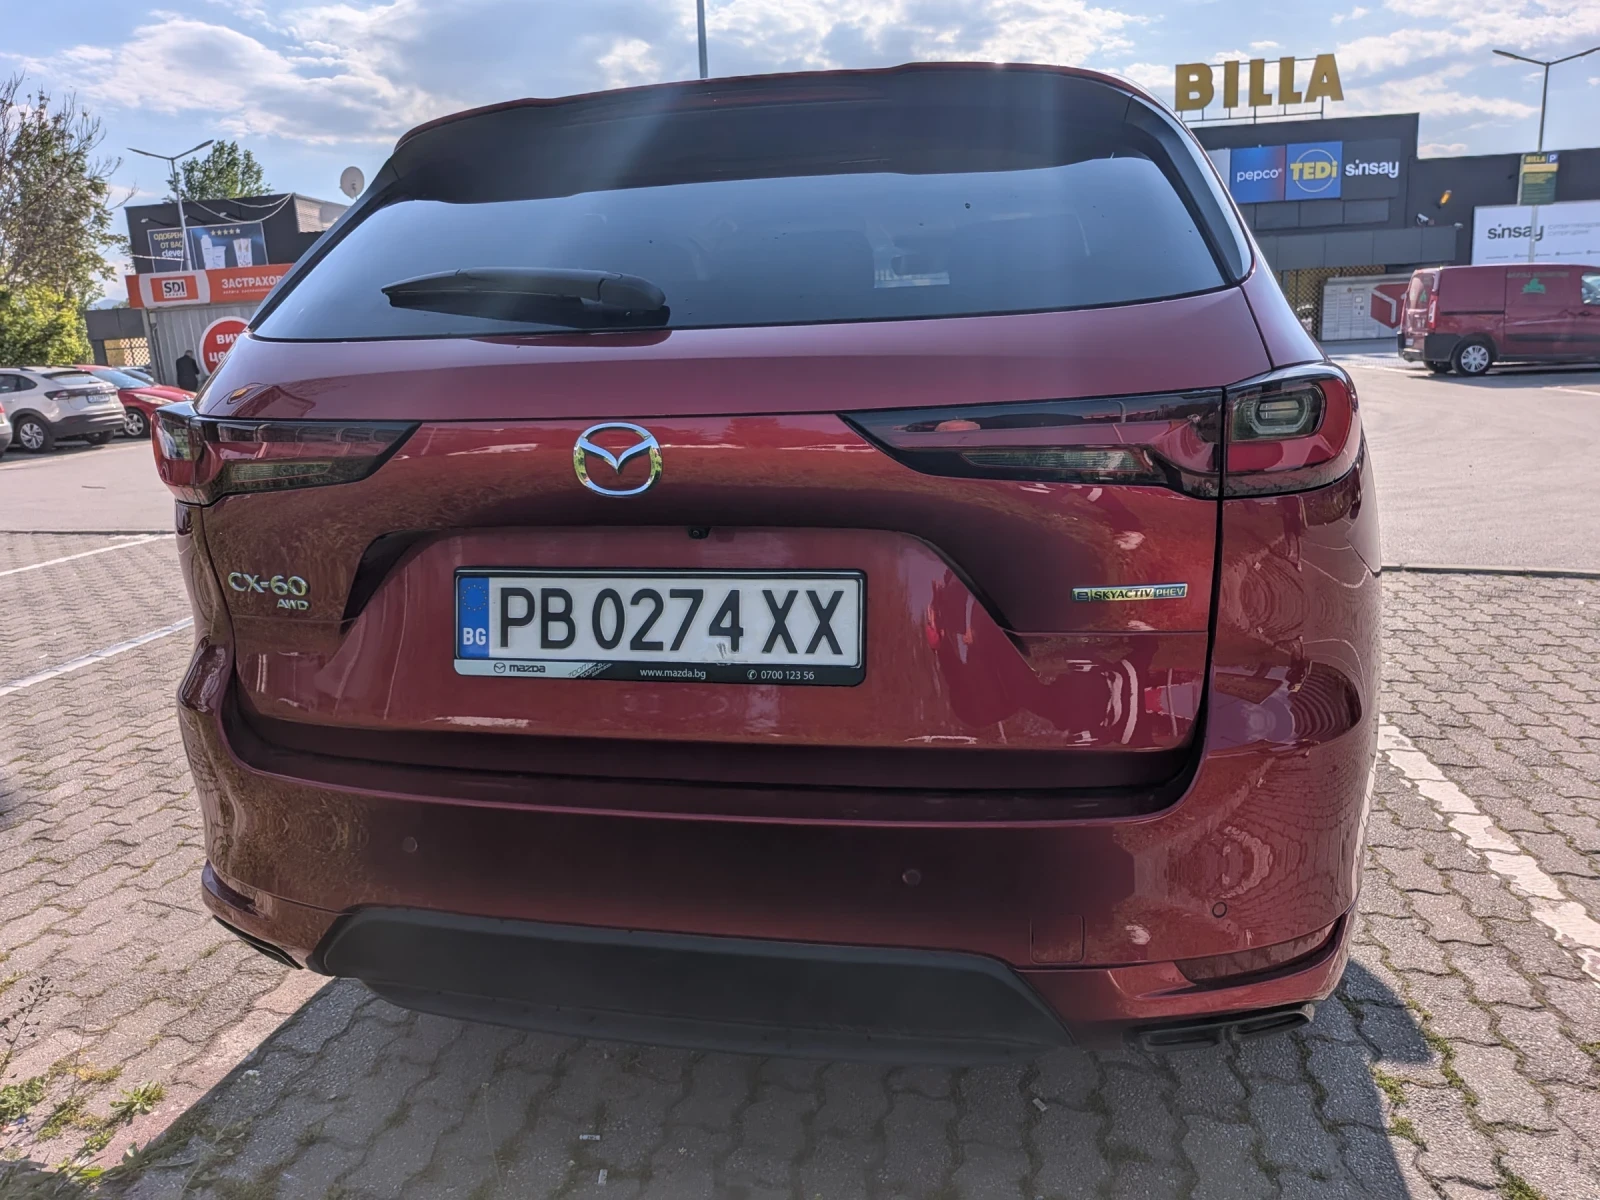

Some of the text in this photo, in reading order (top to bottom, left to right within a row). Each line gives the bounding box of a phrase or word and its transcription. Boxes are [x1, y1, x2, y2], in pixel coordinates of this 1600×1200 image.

[1175, 53, 1344, 111] BILLA
[1345, 159, 1399, 178] sinsay
[1236, 169, 1279, 182] pepco
[164, 281, 185, 293] SDI
[227, 572, 308, 596] CX-60
[1156, 587, 1184, 597] PHEV
[277, 598, 309, 610] AWD
[500, 587, 845, 655] PB 0274 XX
[463, 627, 487, 645] BG
[509, 664, 546, 673] mazda
[640, 669, 706, 680] www.mazda.bg
[760, 671, 815, 680] 0700 123 56
